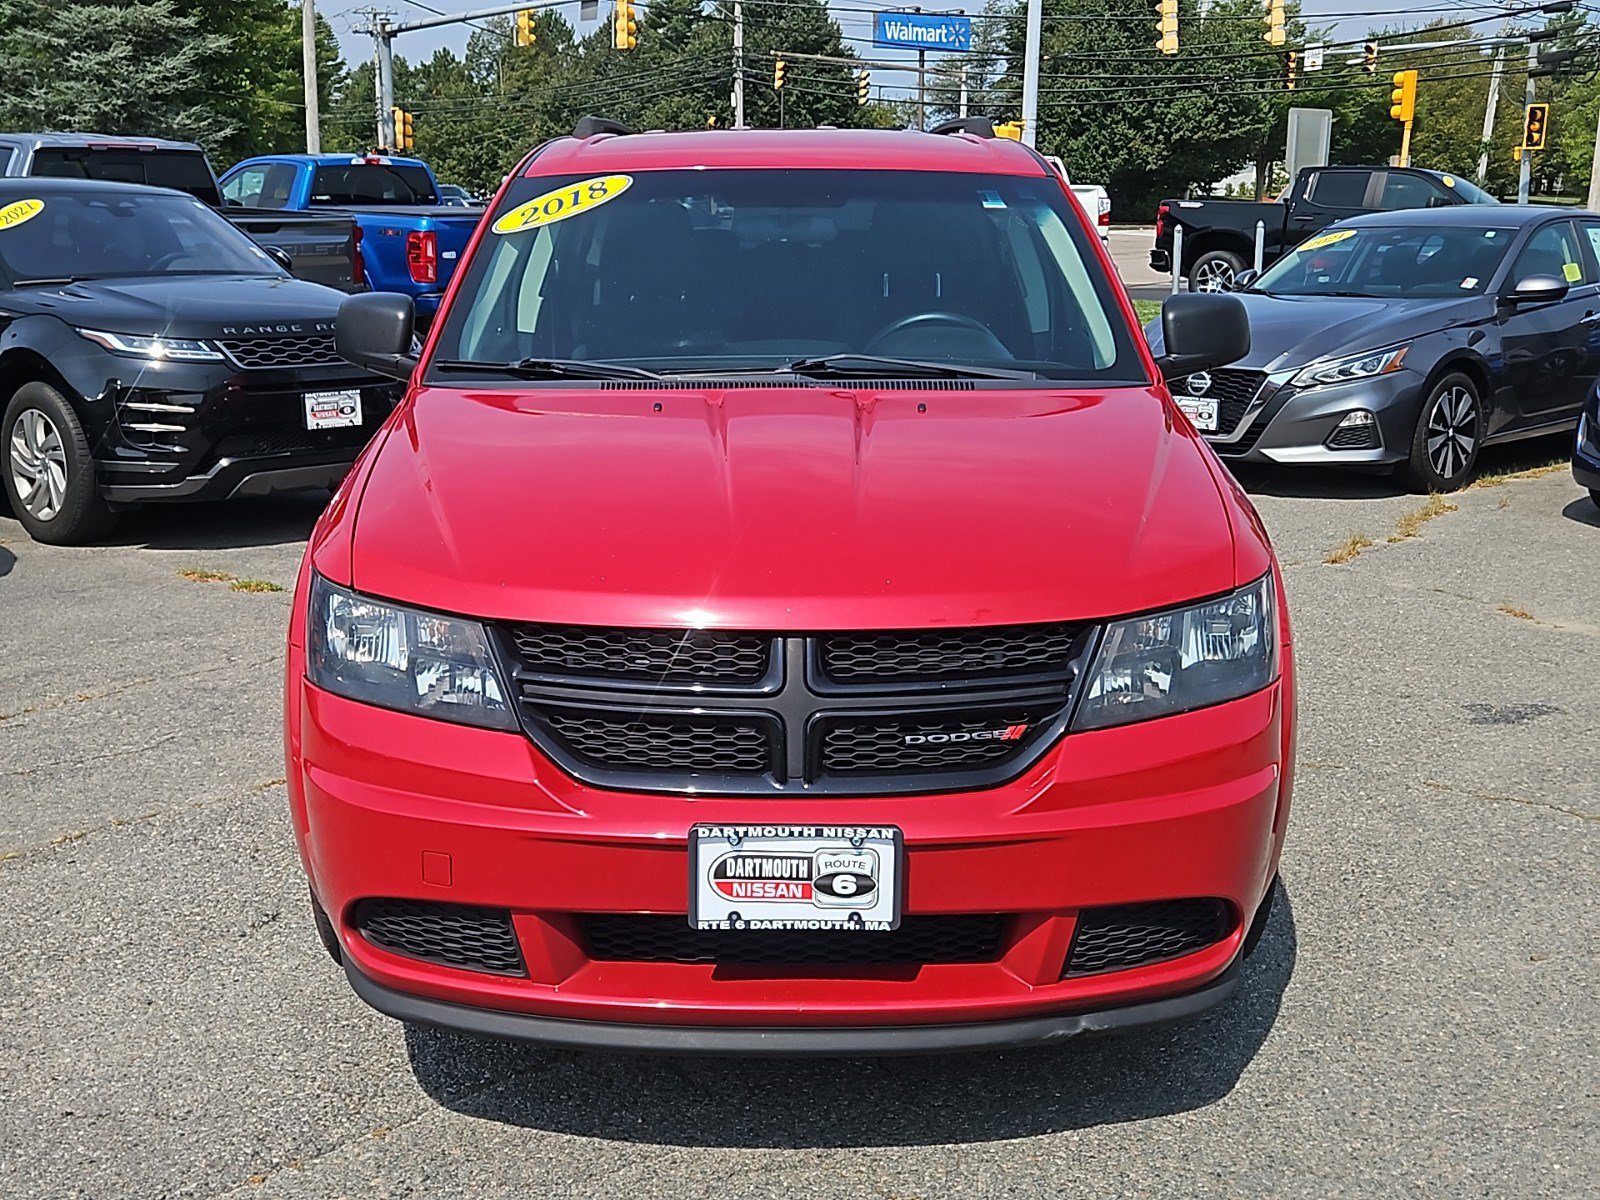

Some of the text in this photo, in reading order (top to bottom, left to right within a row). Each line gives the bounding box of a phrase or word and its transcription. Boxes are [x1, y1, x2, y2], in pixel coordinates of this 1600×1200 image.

[884, 21, 948, 43] Walmart
[520, 181, 608, 226] 2018
[0, 202, 35, 225] 2021
[222, 324, 303, 335] RANGE
[904, 730, 1009, 745] DODGE
[697, 827, 894, 840] DARTMOUTH NISSAN
[726, 858, 809, 879] DARTMOUTH
[824, 860, 867, 870] ROUTE
[732, 883, 803, 899] NISSAN
[831, 874, 858, 895] 6
[698, 920, 731, 930] RTE
[735, 920, 746, 930] 6
[865, 920, 891, 931] MA
